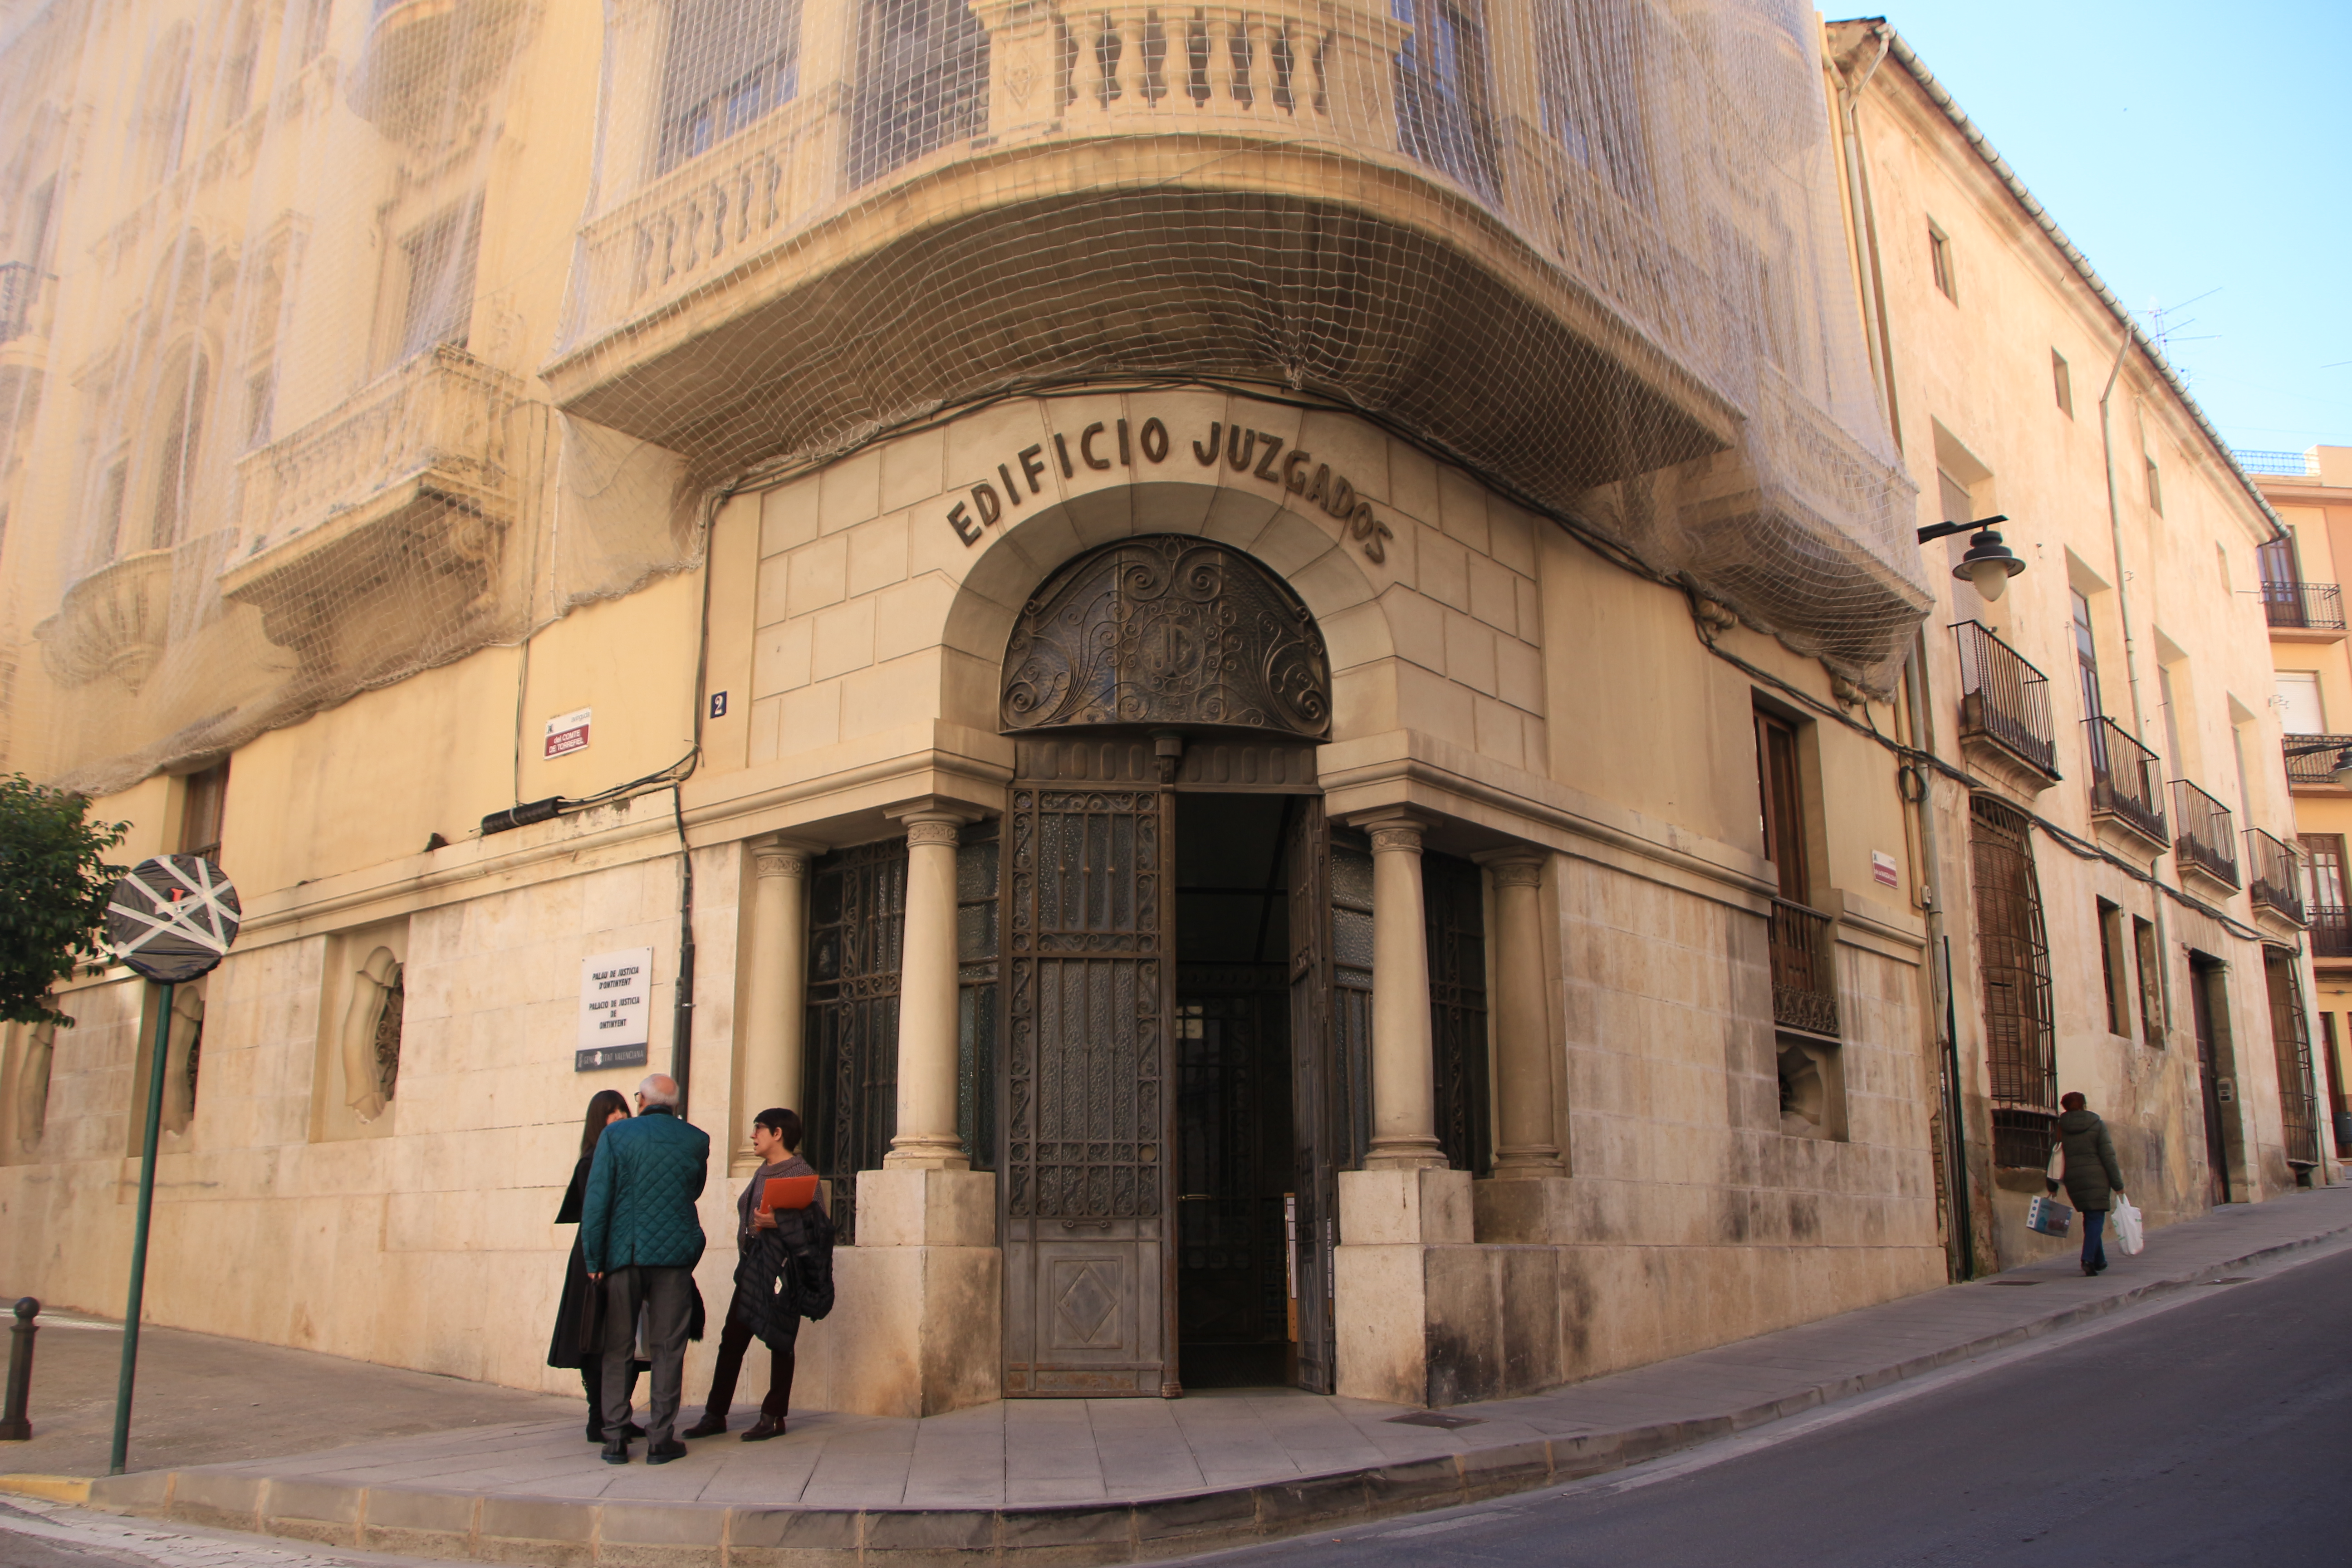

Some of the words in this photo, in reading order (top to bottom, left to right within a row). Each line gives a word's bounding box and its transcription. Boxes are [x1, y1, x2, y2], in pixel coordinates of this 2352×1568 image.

[946, 417, 1169, 547] EDIFICIO
[1193, 421, 1394, 564] JUZGADOS
[714, 695, 723, 715] 2
[562, 729, 581, 741] COMTE
[549, 745, 557, 753] DE
[557, 737, 584, 751] TORREFIEL
[592, 971, 608, 980] PALAU
[599, 977, 631, 990] D'ONTINYENT
[589, 1001, 608, 1010] PALACIO
[619, 996, 639, 1006] JUSTICIA
[599, 1019, 626, 1029] ONTINYENT
[615, 1050, 643, 1060] VALENCIANA
